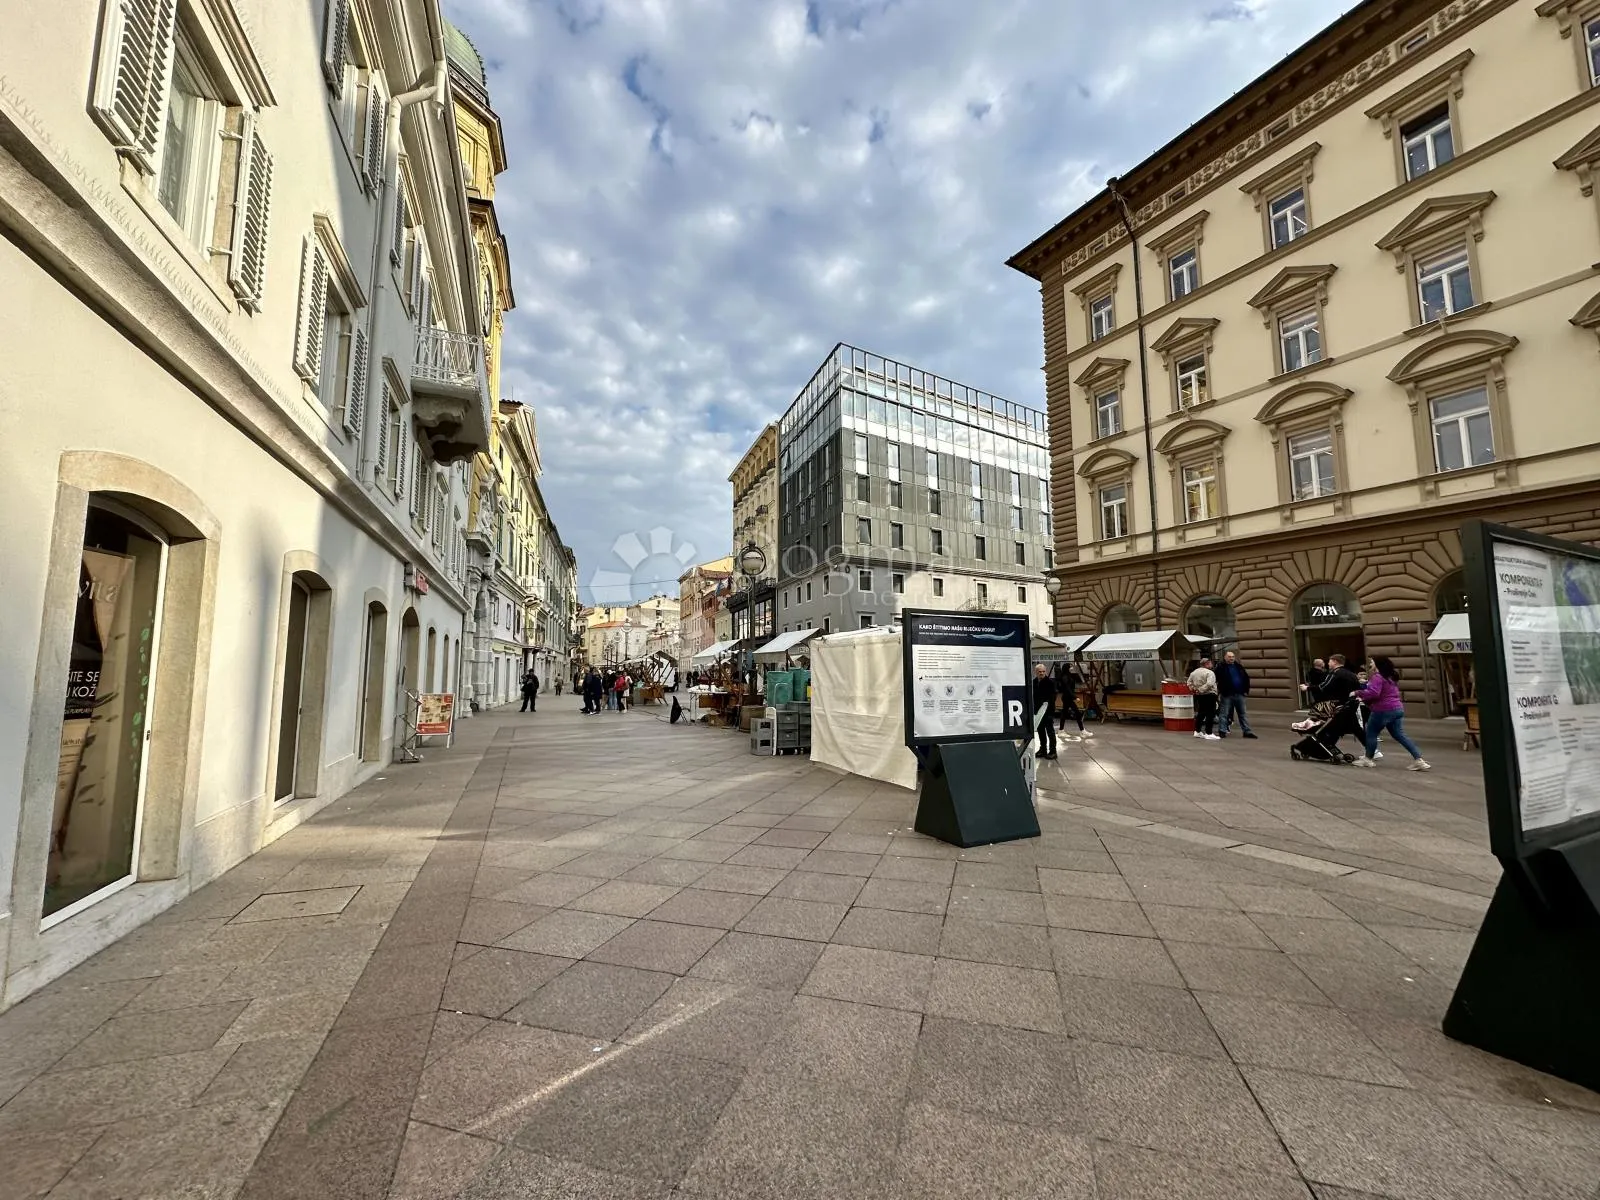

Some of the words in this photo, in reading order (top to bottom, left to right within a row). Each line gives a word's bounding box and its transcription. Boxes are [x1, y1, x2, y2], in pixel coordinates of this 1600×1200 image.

[1311, 605, 1339, 617] ZARA
[86, 671, 100, 682] SE
[1008, 700, 1023, 727] R
